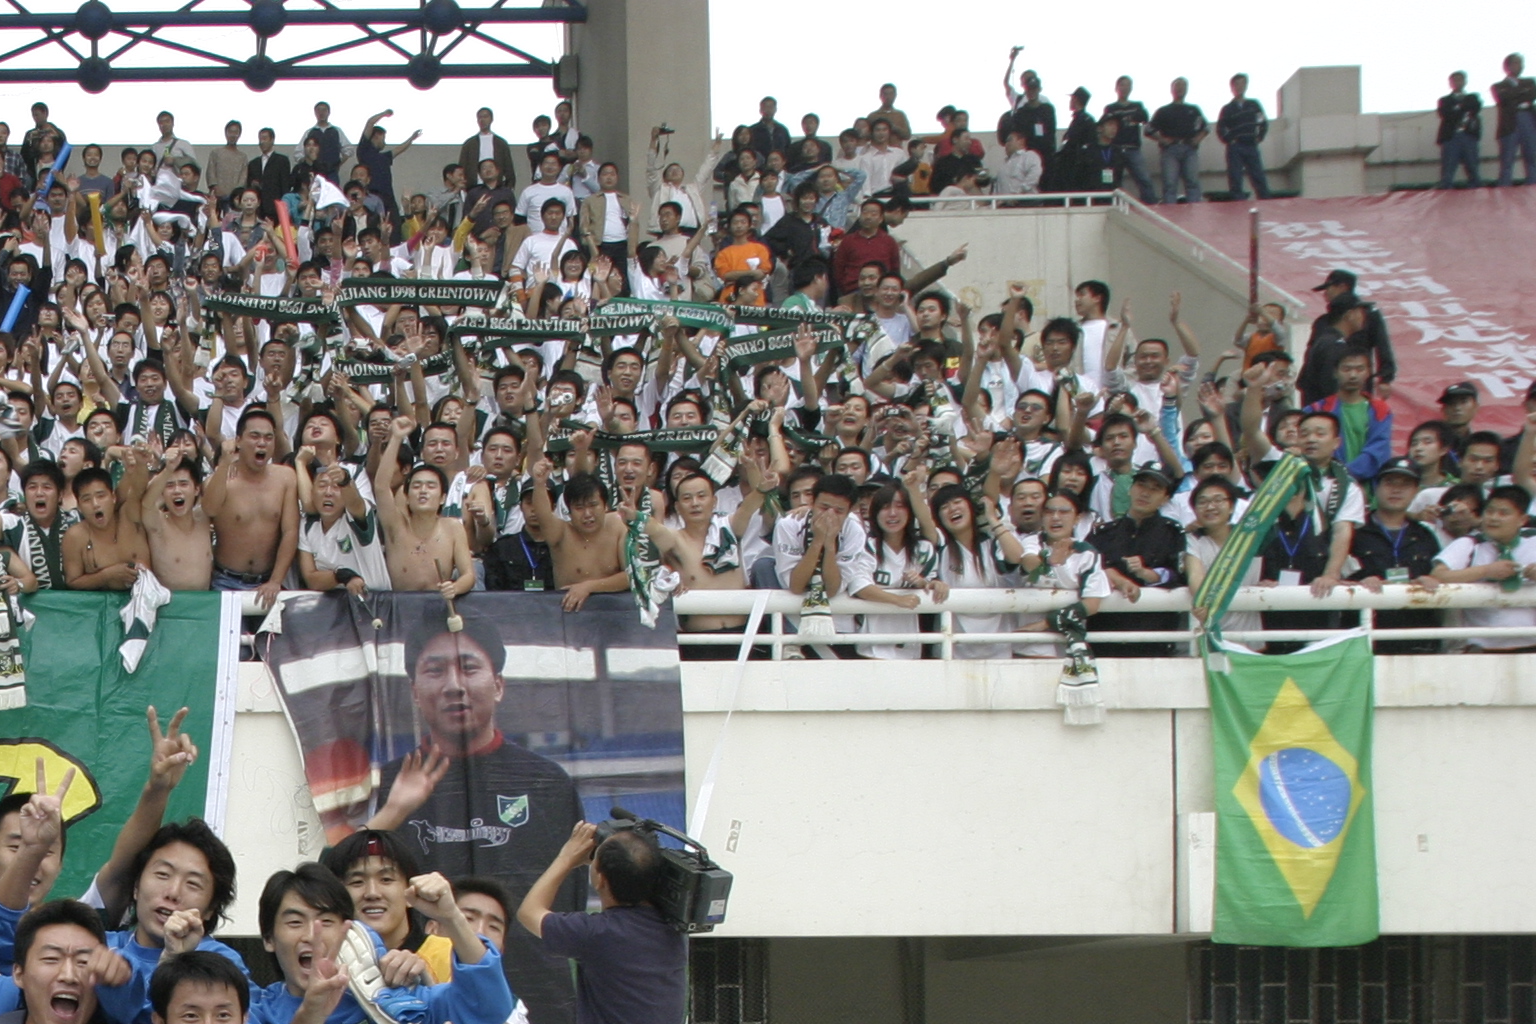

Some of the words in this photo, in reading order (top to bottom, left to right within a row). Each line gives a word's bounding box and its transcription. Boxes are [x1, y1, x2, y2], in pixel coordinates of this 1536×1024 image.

[390, 284, 416, 298] 1998
[417, 285, 497, 302] GREENTOWN
[489, 318, 518, 333] 1998
